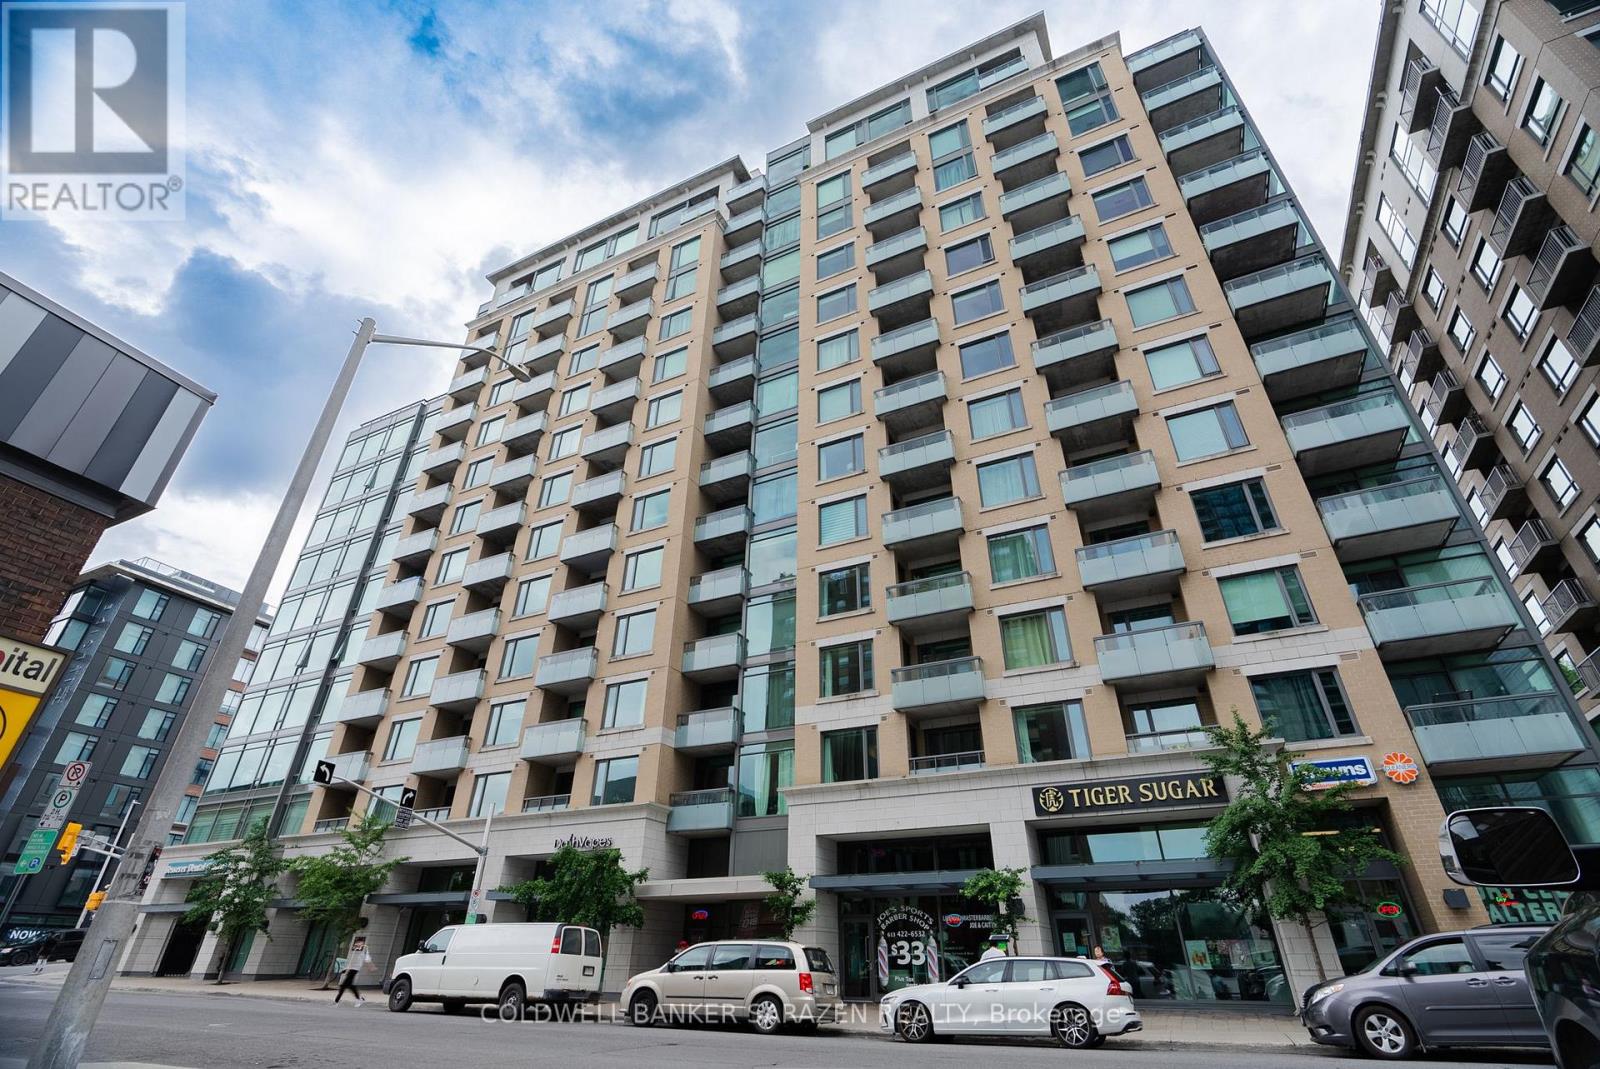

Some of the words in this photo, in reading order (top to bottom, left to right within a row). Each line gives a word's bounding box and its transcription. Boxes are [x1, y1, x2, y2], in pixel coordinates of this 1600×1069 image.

[1068, 785, 1134, 808] TIGER
[1139, 778, 1218, 802] SUGAR
[900, 905, 934, 925] SPORTS
[1378, 905, 1399, 914] OPEN
[880, 913, 907, 930] BARBER
[909, 915, 930, 930] SHOP
[891, 940, 926, 965] $33
